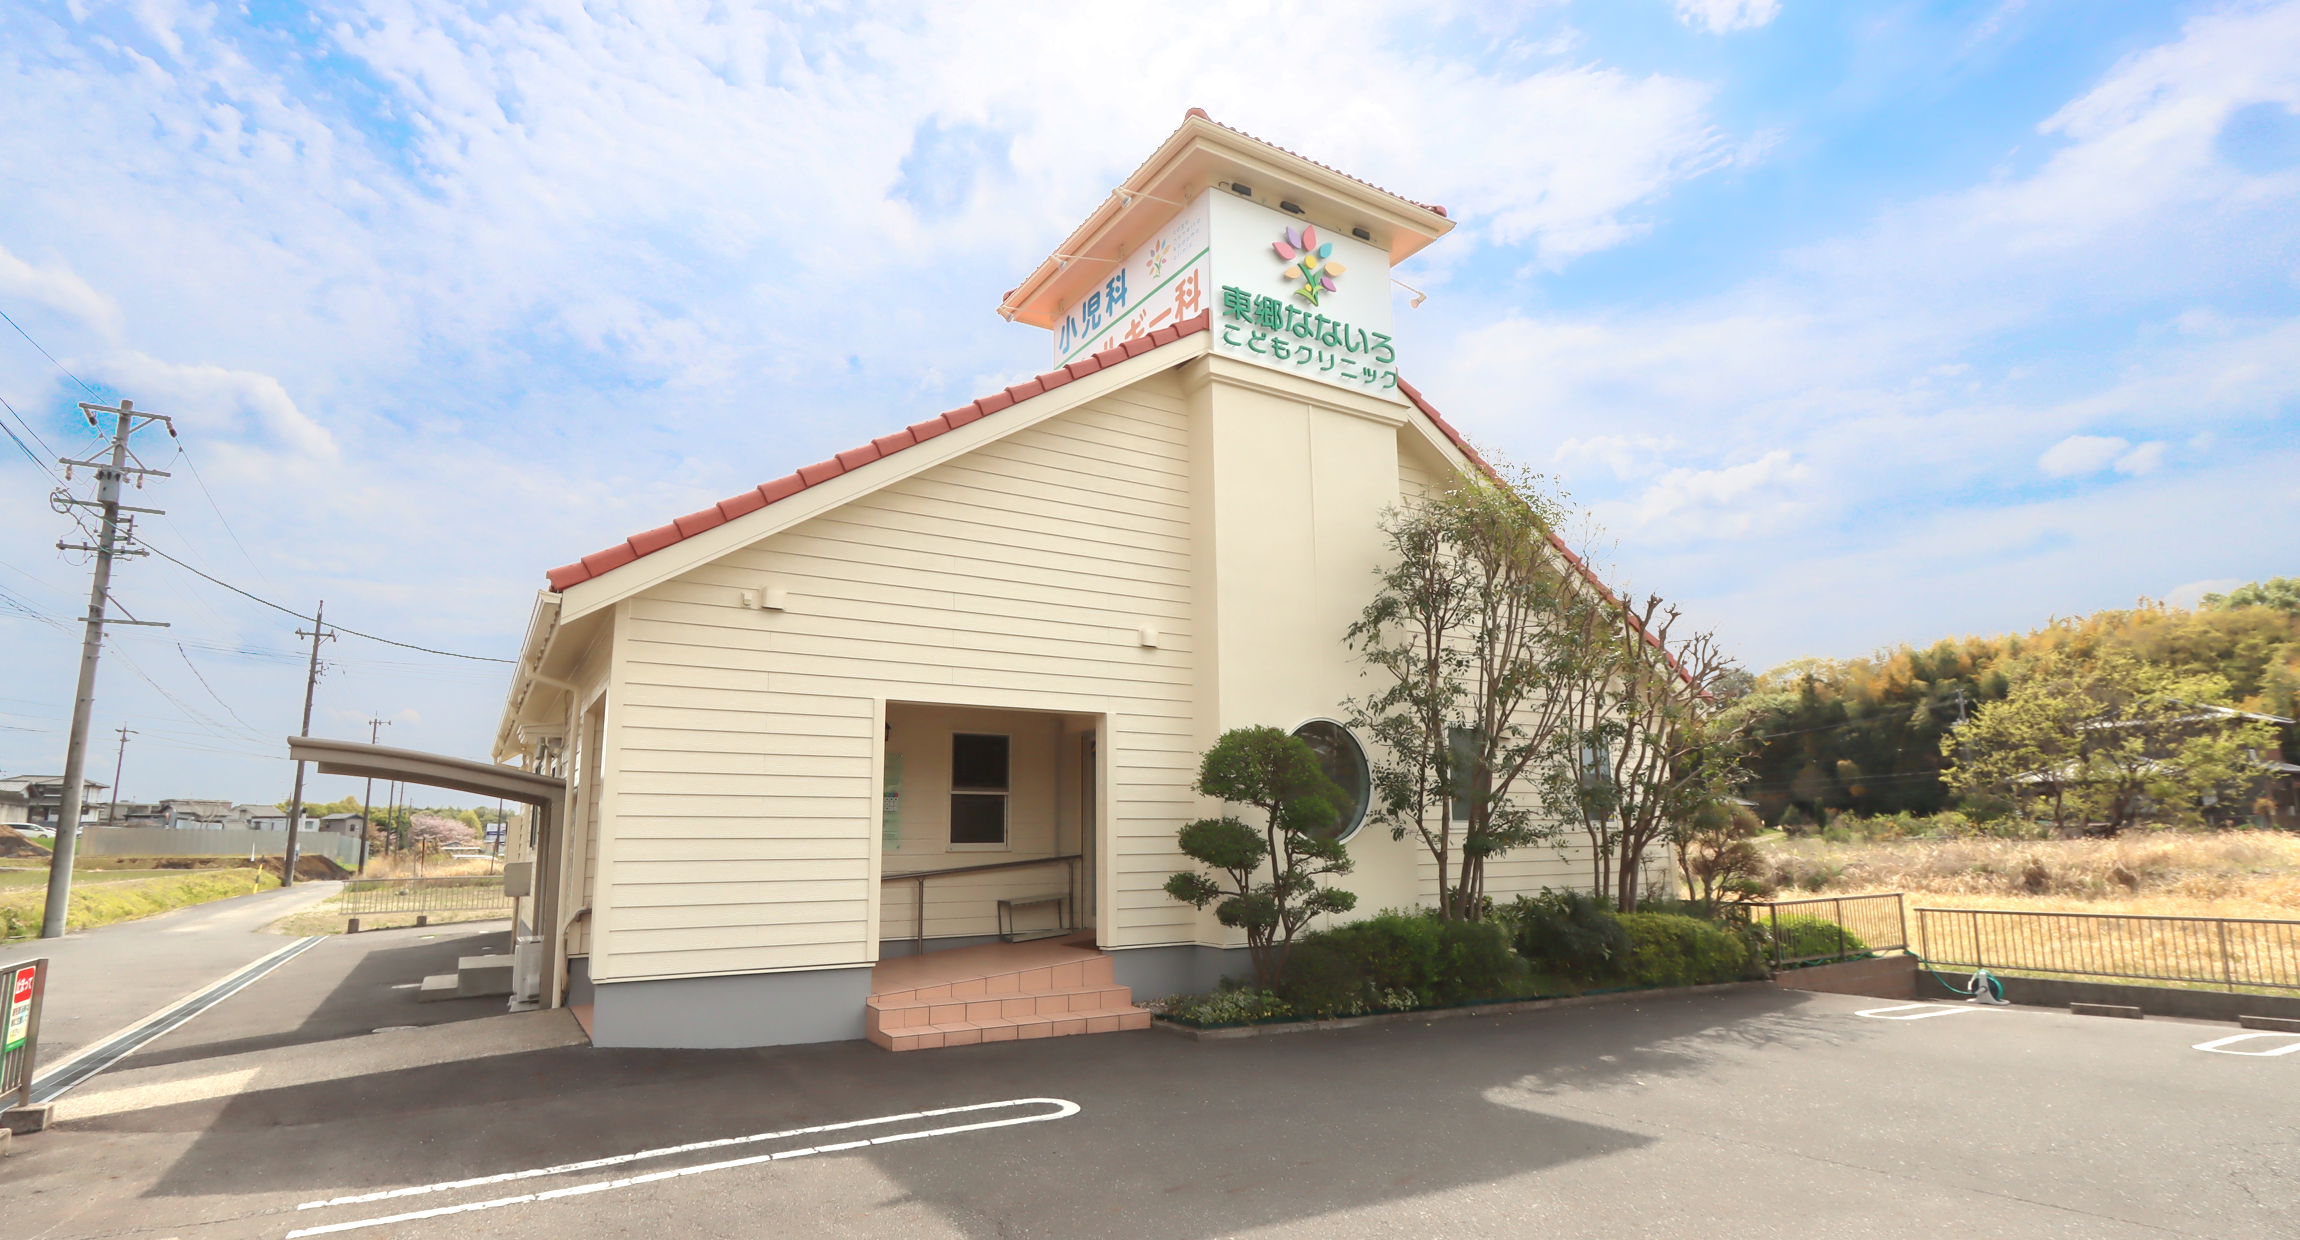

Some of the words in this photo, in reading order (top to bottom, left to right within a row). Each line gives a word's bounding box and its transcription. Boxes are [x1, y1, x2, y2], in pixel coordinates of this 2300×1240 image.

[1059, 267, 1128, 355] 小児科
[1222, 285, 1396, 364] 東郷なないろ
[1223, 324, 1398, 389] こどもクリニック
[15, 976, 34, 995] 止まって
